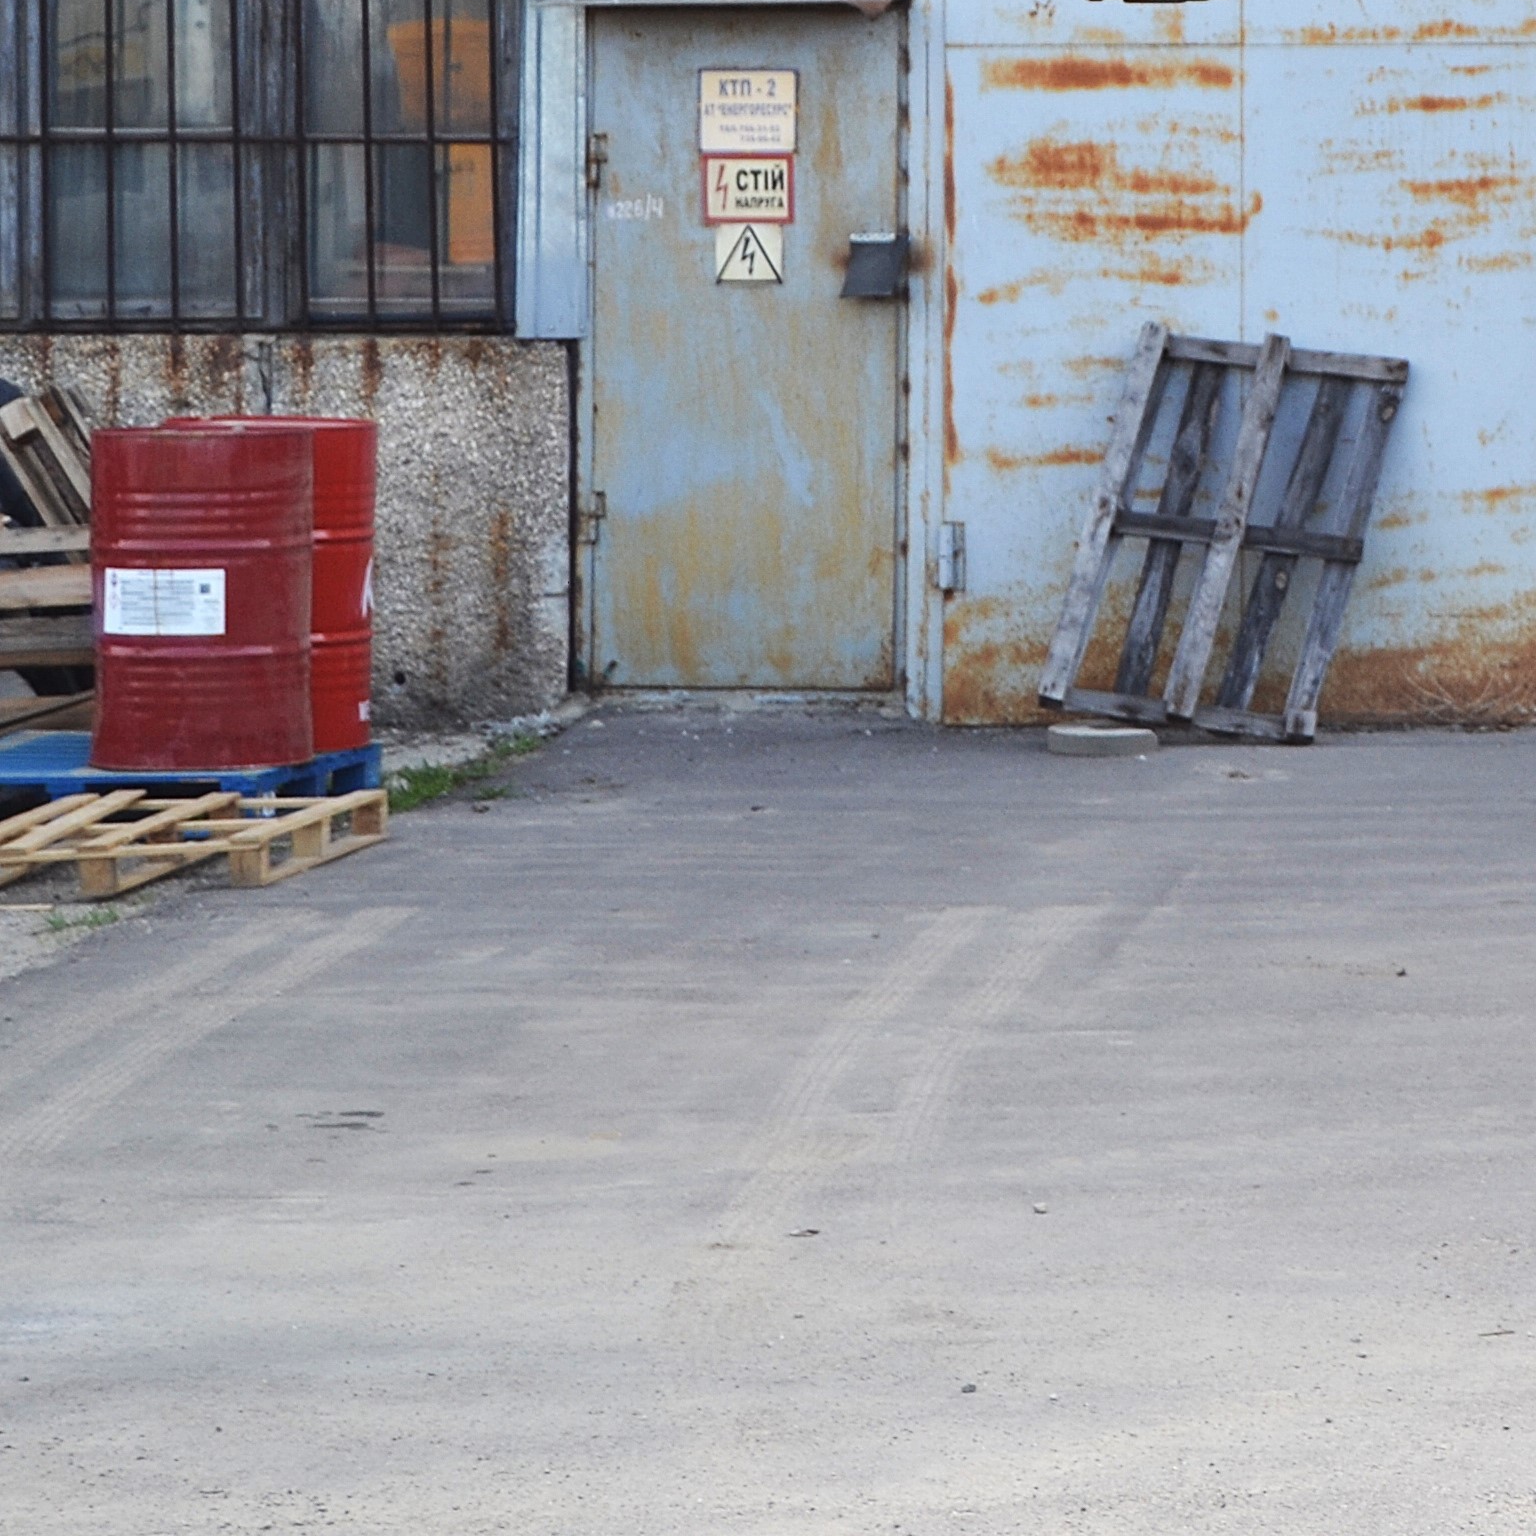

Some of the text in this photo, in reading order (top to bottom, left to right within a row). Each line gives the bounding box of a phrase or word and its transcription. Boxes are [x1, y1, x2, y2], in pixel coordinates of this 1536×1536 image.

[719, 78, 751, 97] КТП
[766, 78, 776, 96] 2
[736, 164, 784, 191] СТІЙ
[735, 196, 784, 209] НАПРУГА
